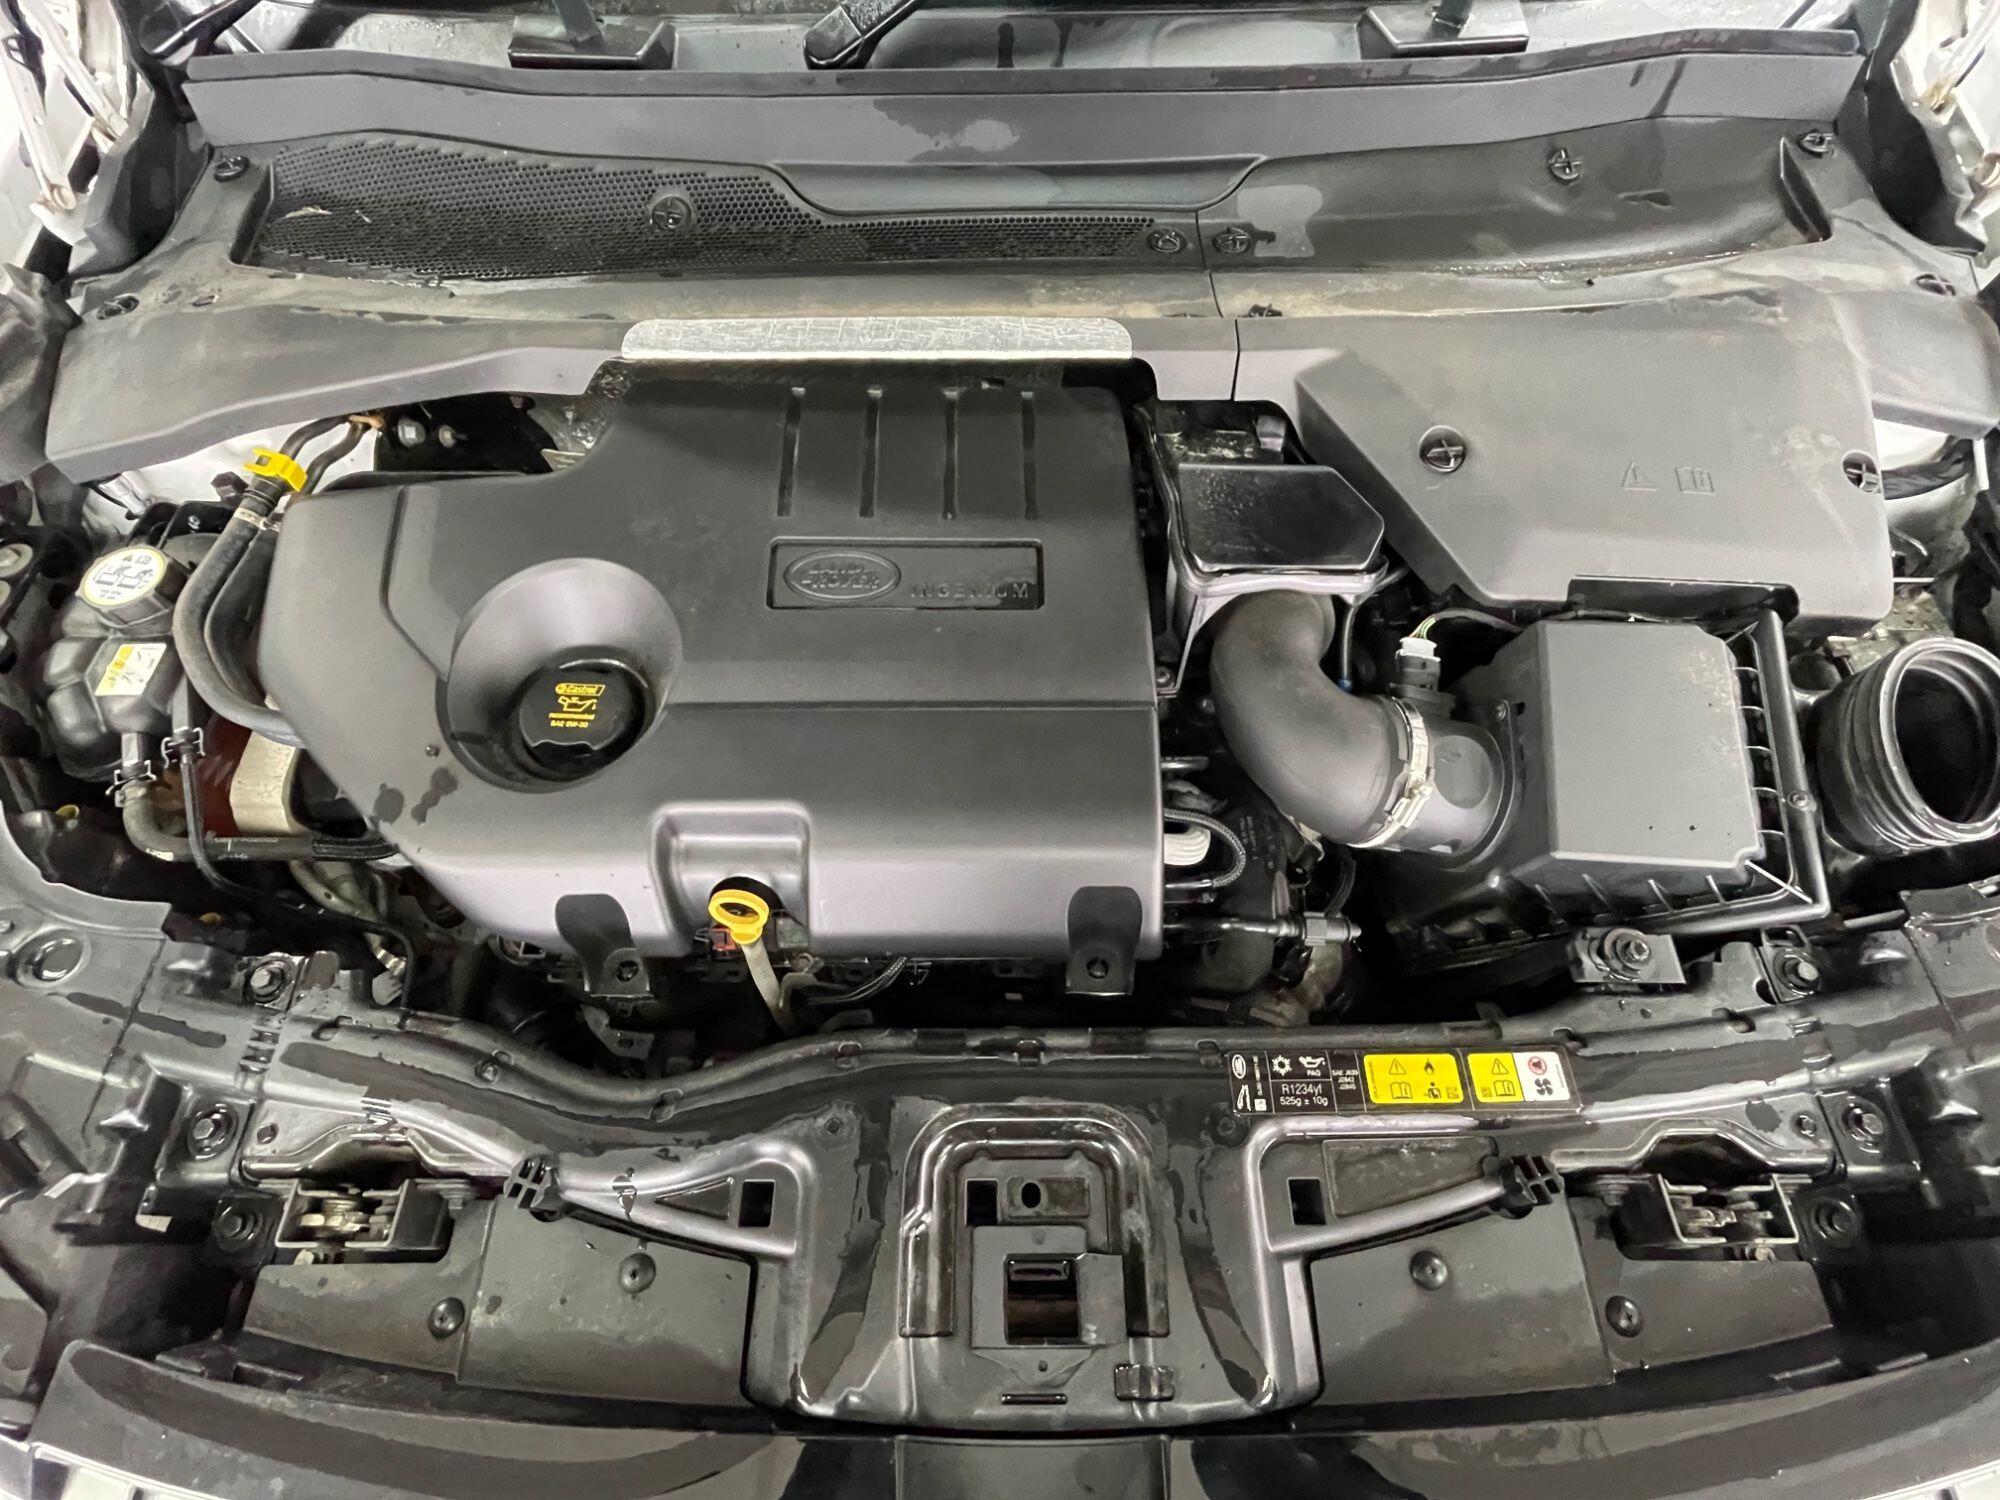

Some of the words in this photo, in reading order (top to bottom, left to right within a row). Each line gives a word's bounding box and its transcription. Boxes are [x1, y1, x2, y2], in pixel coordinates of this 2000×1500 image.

[812, 574, 880, 590] ROVER
[566, 684, 599, 694] Castrol
[550, 720, 565, 728] SAE
[565, 720, 589, 729] 0W-30
[1281, 1083, 1323, 1095] R1234yf
[1280, 1096, 1302, 1107] 525g
[1312, 1096, 1329, 1107] 10g
